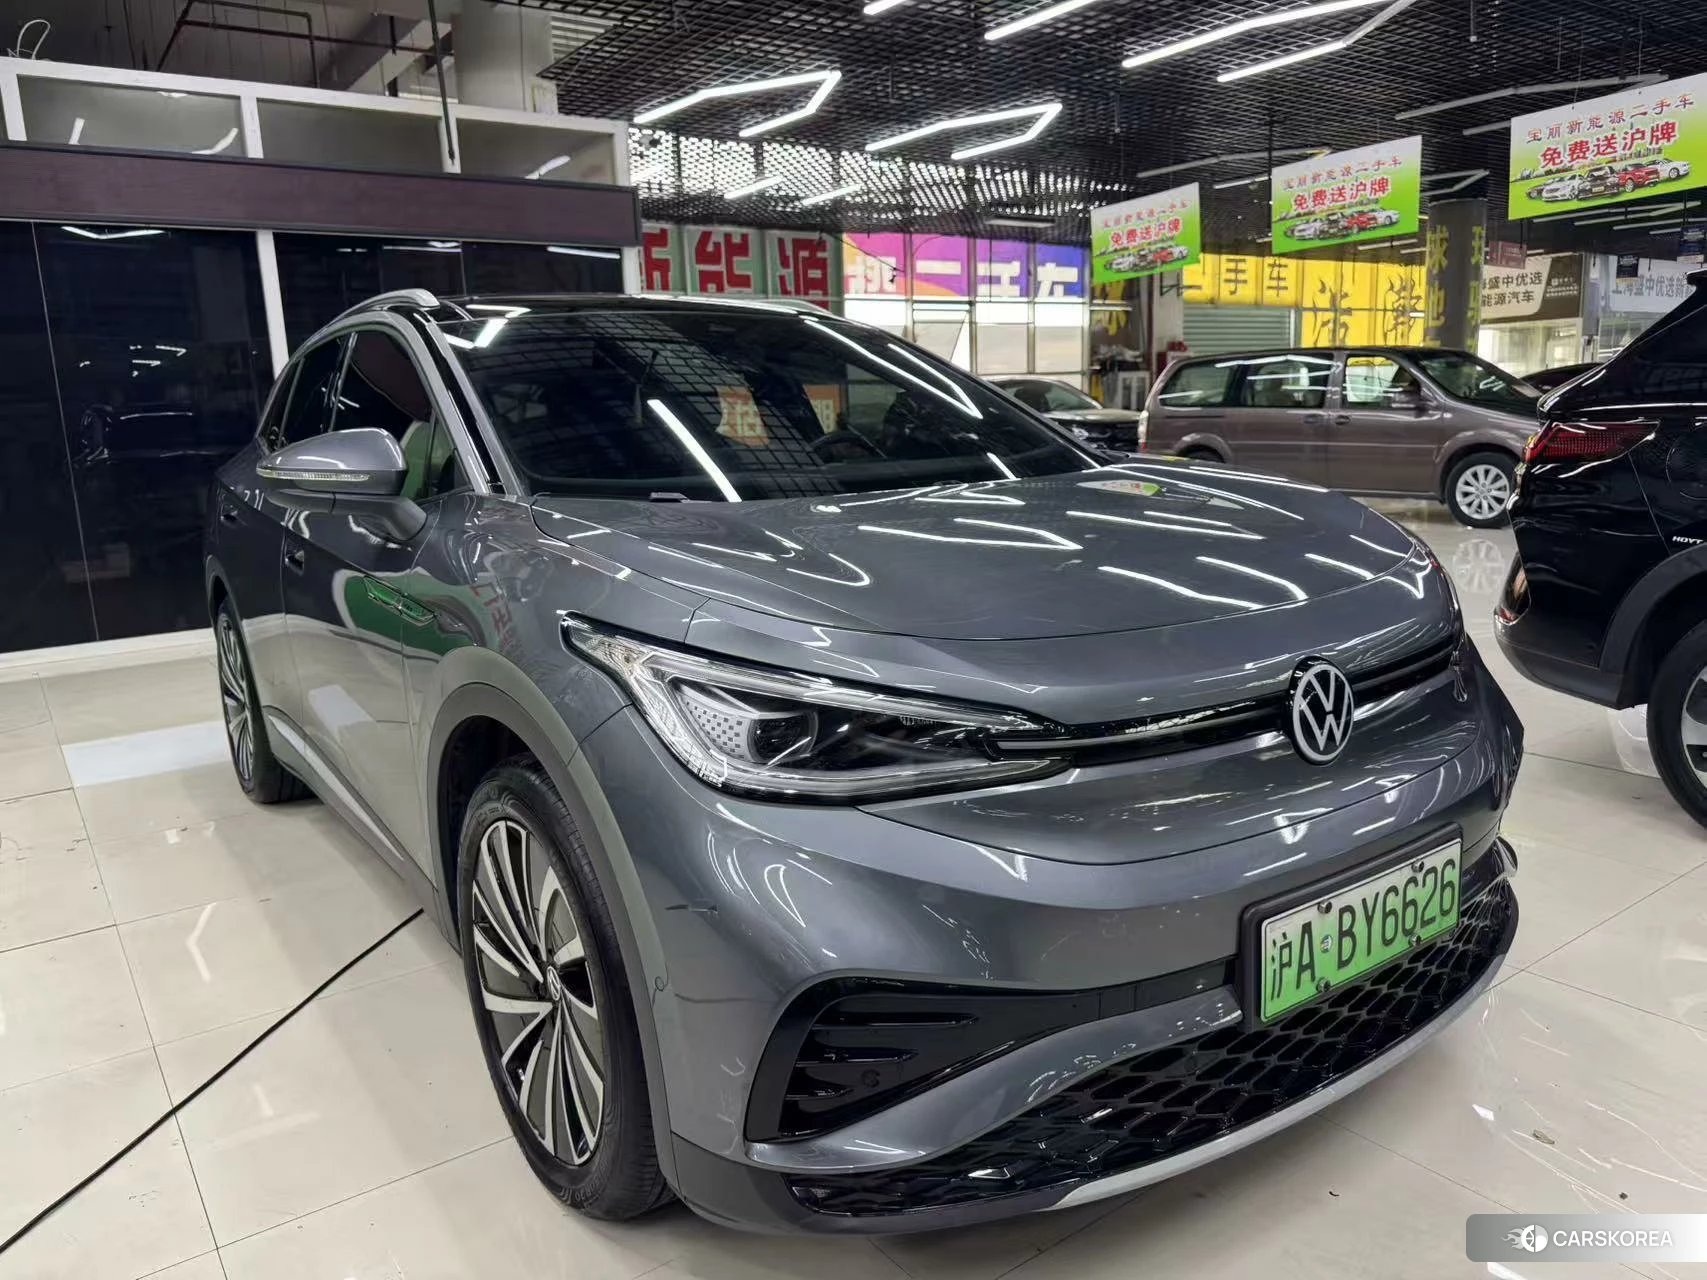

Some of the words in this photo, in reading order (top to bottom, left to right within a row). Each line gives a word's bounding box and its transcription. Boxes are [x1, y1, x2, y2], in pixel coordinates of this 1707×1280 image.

[1540, 121, 1677, 168] 免费送沪牌
[1294, 177, 1390, 210] 免费送沪牌
[1271, 921, 1316, 1001] 沪A
[1337, 859, 1456, 971] BY6626
